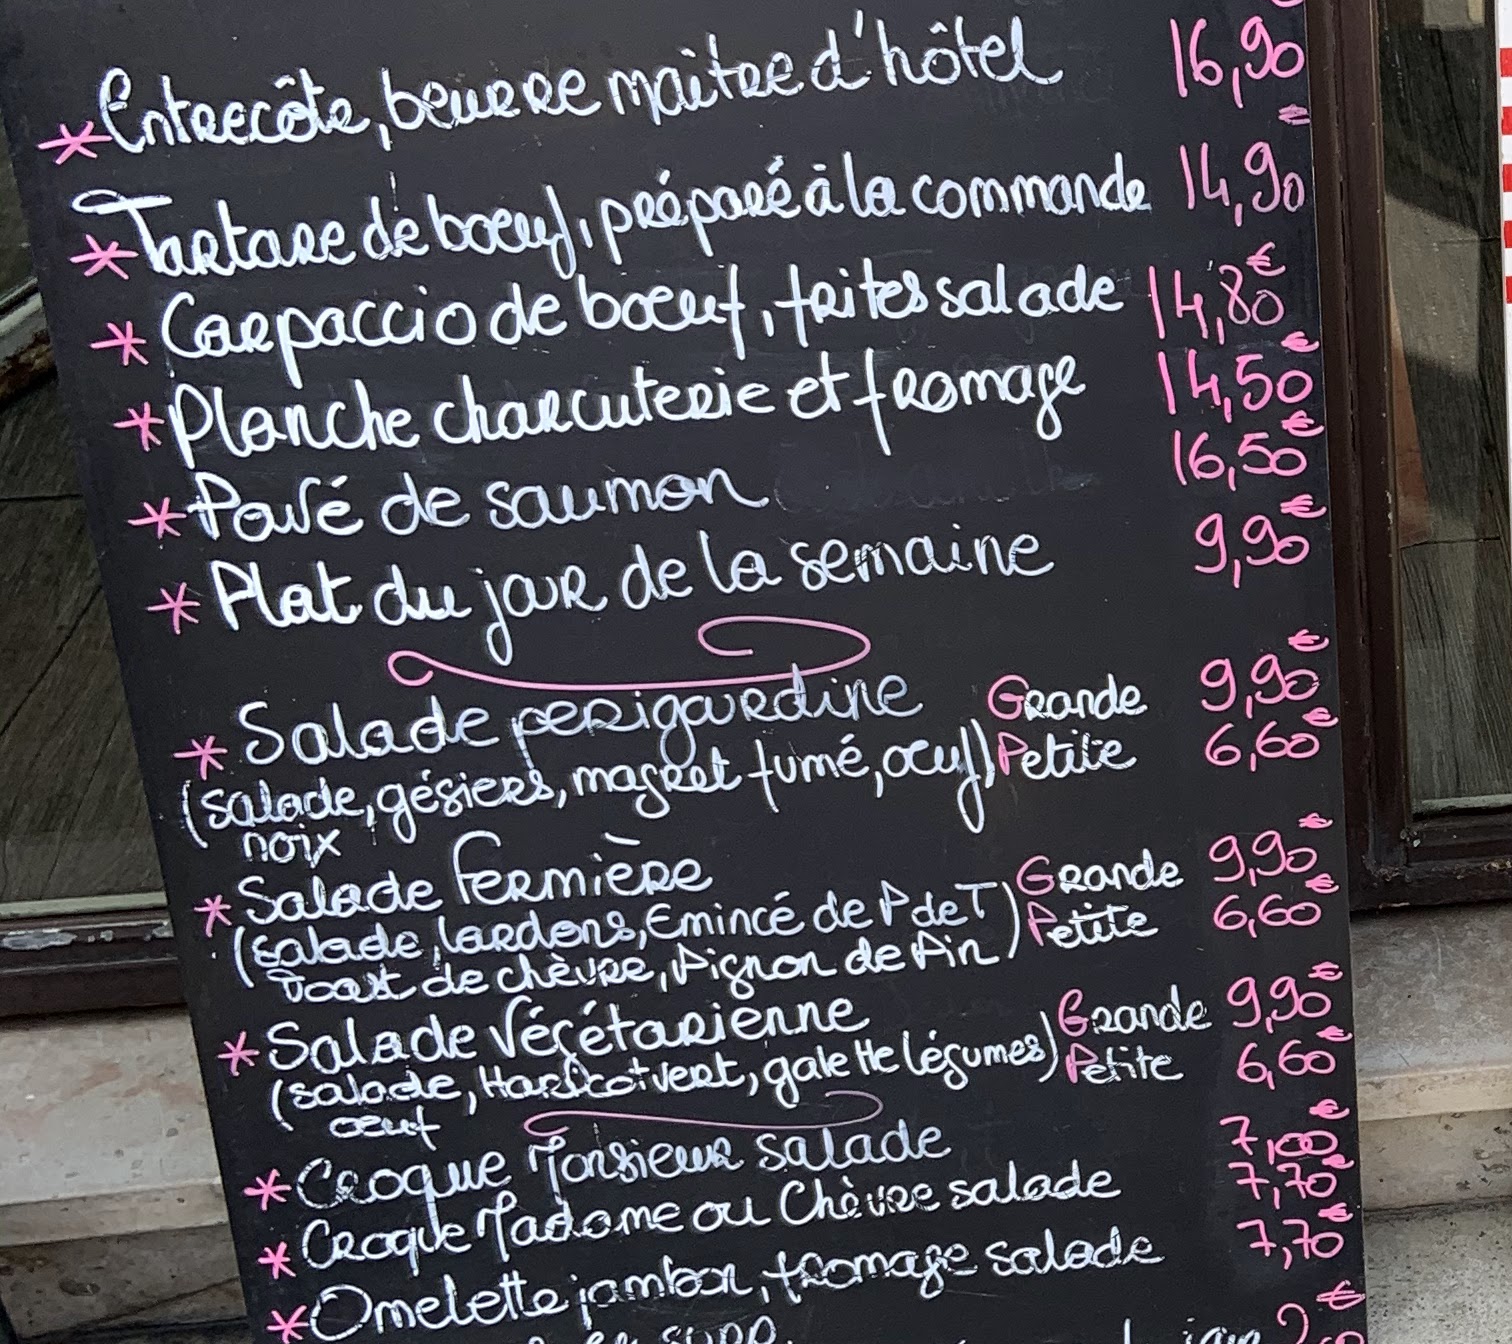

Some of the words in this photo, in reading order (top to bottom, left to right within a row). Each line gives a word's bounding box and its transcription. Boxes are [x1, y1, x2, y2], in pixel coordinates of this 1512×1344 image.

[811, 9, 1063, 91] d'hôtel
[71, 189, 358, 277] Tartare
[362, 193, 430, 260] de
[600, 156, 802, 265] préparé
[806, 163, 844, 216] à
[842, 150, 905, 219] la
[911, 150, 1152, 220] commande
[160, 286, 479, 390] Carpaccio
[490, 282, 568, 344] de
[774, 256, 930, 348] frites
[939, 263, 1125, 320] salade
[168, 378, 421, 469] Planche
[433, 365, 776, 446] charcuterie
[789, 350, 851, 421] et
[853, 347, 1087, 456] fromage
[187, 470, 363, 543] Pavé
[379, 471, 470, 535] de
[486, 466, 769, 531] saumon
[208, 560, 362, 632] Plat
[372, 564, 473, 628] du
[469, 564, 608, 666] jour
[620, 544, 695, 612] de
[697, 528, 783, 594] la
[789, 522, 1056, 592] semaine
[238, 695, 502, 766] Salade
[986, 673, 1148, 721] Grande
[572, 746, 743, 819] magret
[998, 727, 1138, 782] Petite
[237, 870, 443, 926] Salade
[1015, 847, 1186, 897] Grande
[243, 823, 344, 868] noix
[421, 962, 490, 999] de
[670, 943, 838, 999] Pignon
[843, 937, 907, 976] de
[910, 931, 1001, 970] Pin
[266, 1013, 478, 1075] Salade
[1056, 984, 1213, 1037] Grande
[297, 1150, 513, 1232] Croque
[757, 1119, 953, 1173] salade
[301, 1217, 473, 1276] Croque
[691, 1195, 772, 1228] ou
[780, 1174, 941, 1228] Chèvre
[949, 1158, 1122, 1210] salade
[308, 1271, 572, 1343] Omelette
[984, 1226, 1166, 1277] salade
